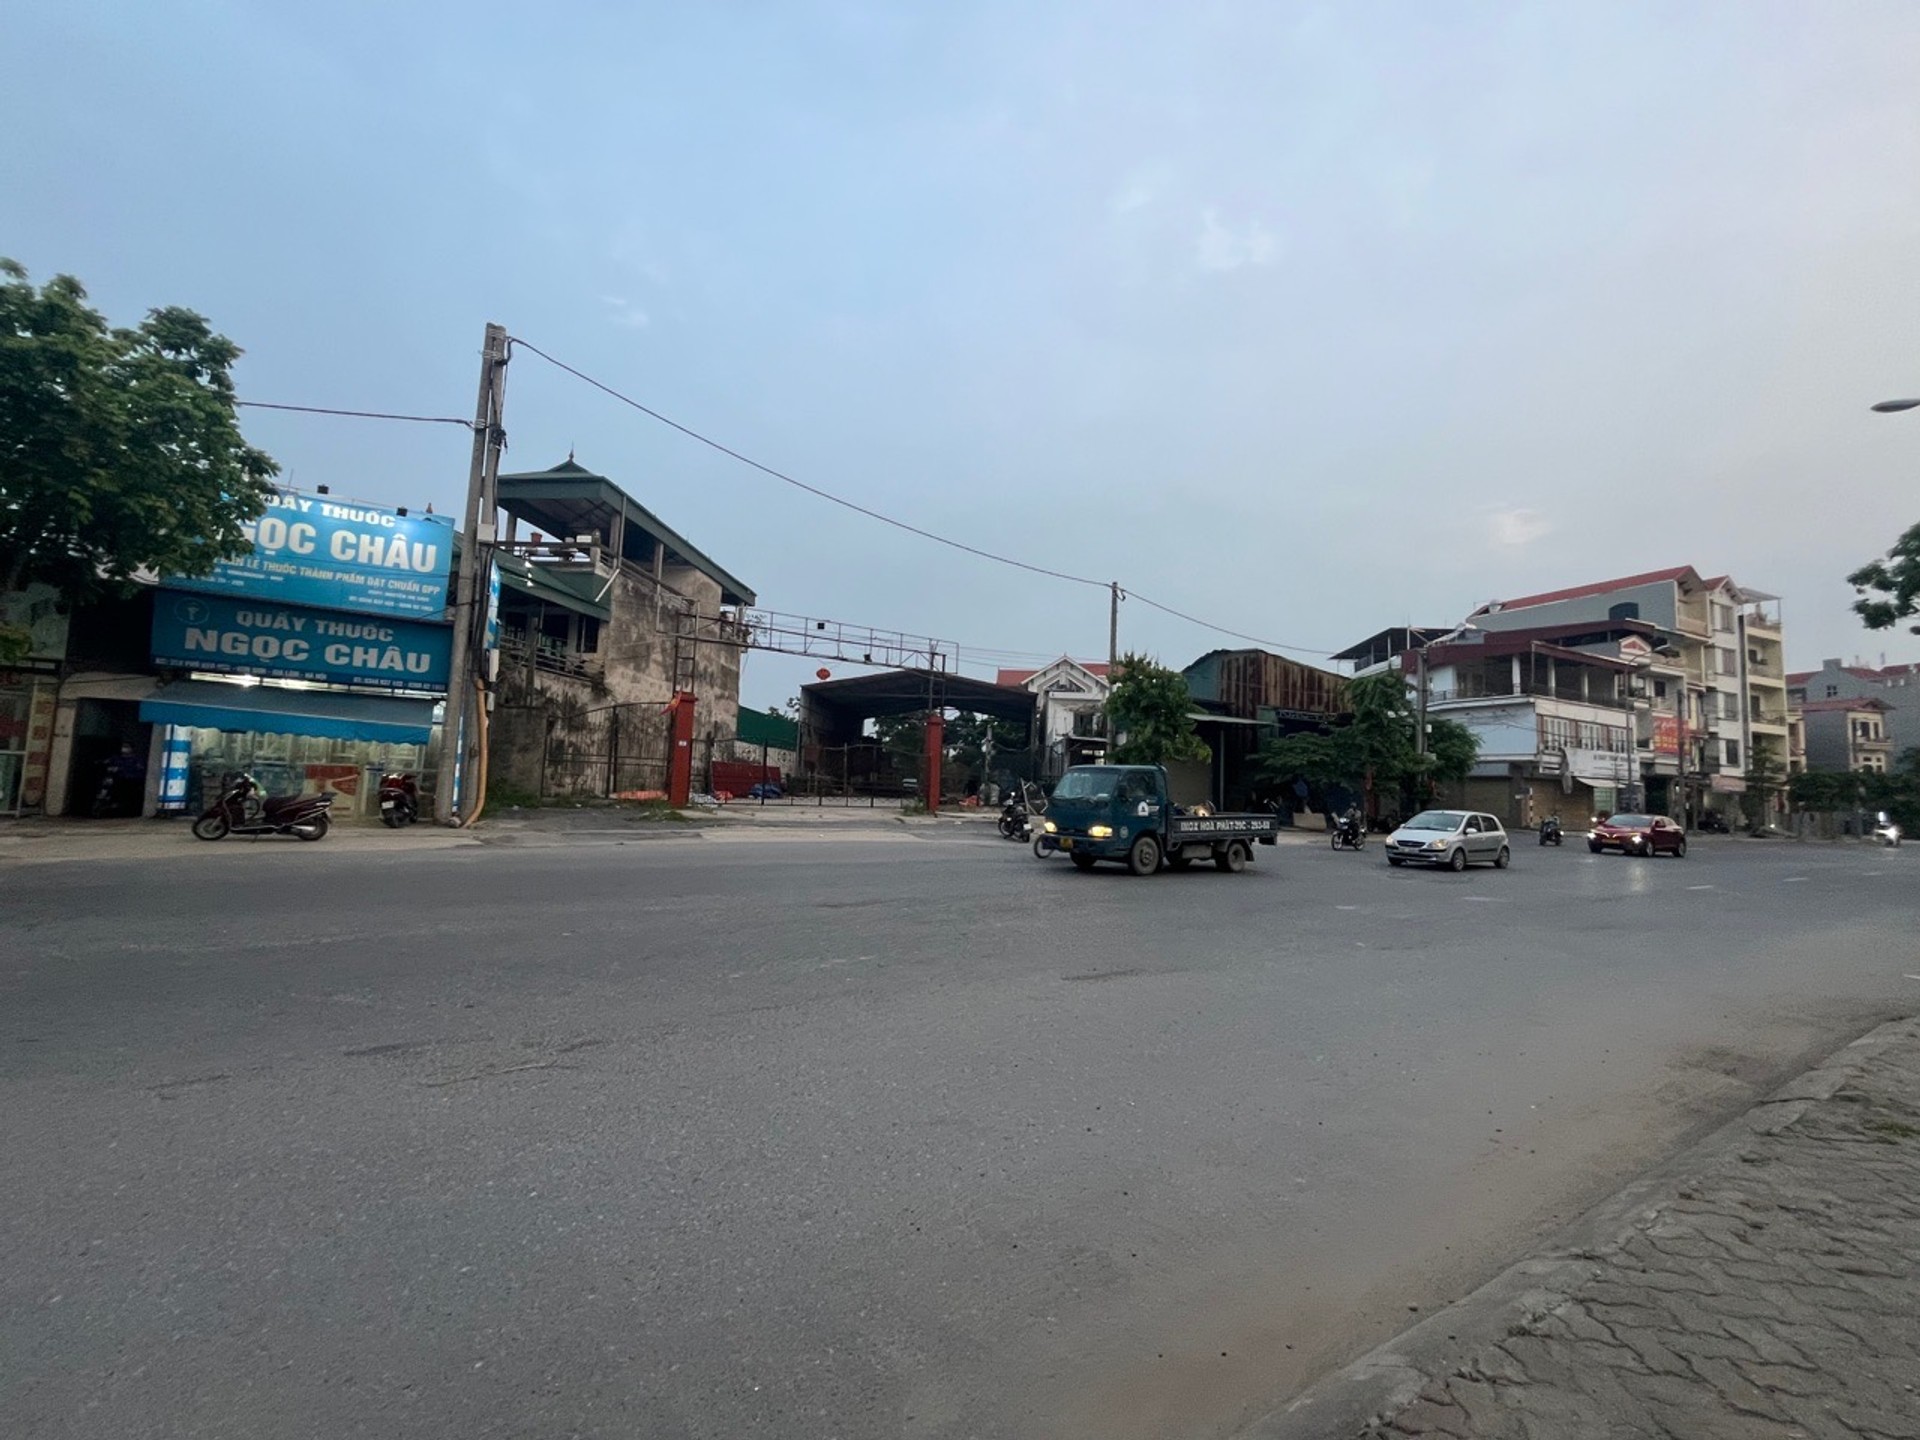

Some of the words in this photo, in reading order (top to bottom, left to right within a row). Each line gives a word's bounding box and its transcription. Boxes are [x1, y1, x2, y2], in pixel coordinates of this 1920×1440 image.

[320, 502, 397, 529] THUỐC
[329, 530, 437, 573] CHÂU
[315, 618, 395, 643] THUỐC
[184, 627, 310, 663] NGỌC
[324, 643, 431, 674] CHÂU
